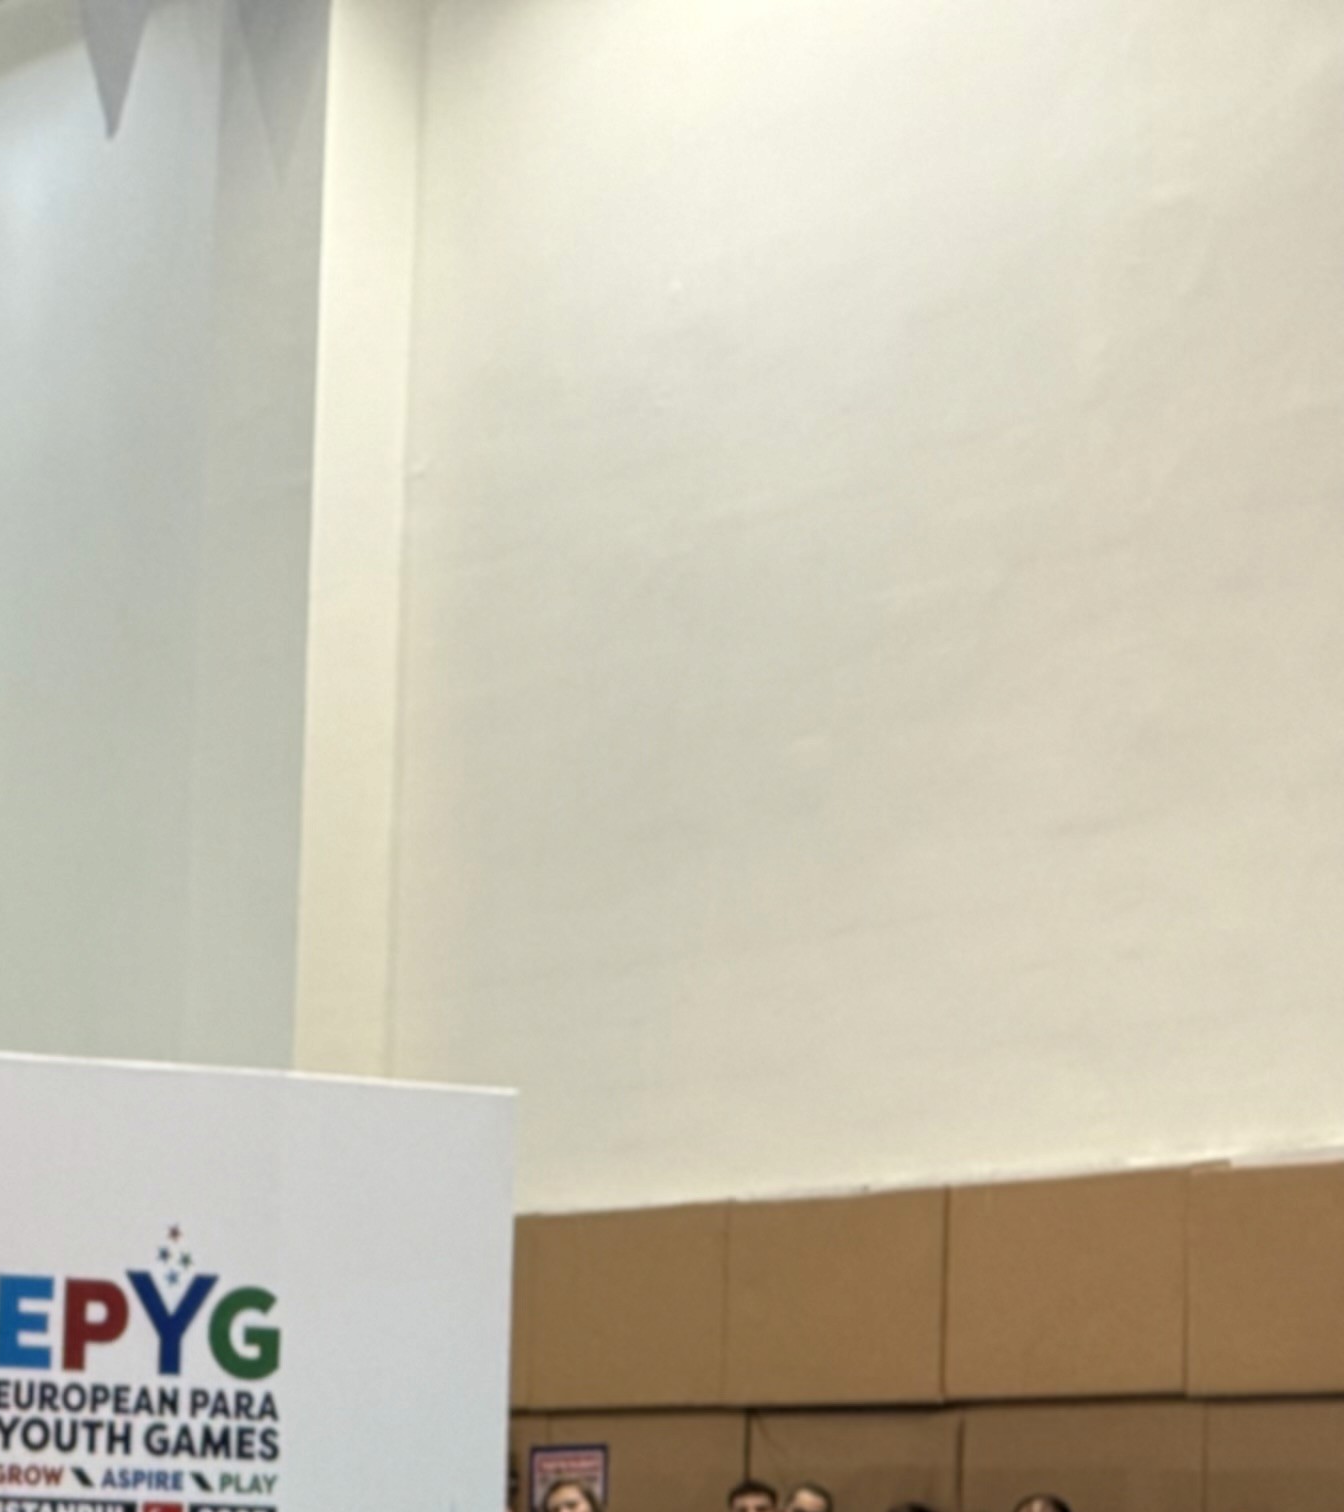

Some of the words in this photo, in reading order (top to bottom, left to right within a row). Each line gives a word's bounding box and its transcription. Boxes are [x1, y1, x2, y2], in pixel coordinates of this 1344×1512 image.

[190, 1387, 279, 1422] PARA
[143, 1422, 280, 1461] GAMES
[100, 1468, 184, 1491] ASPIRE
[219, 1472, 278, 1495] PLAY
